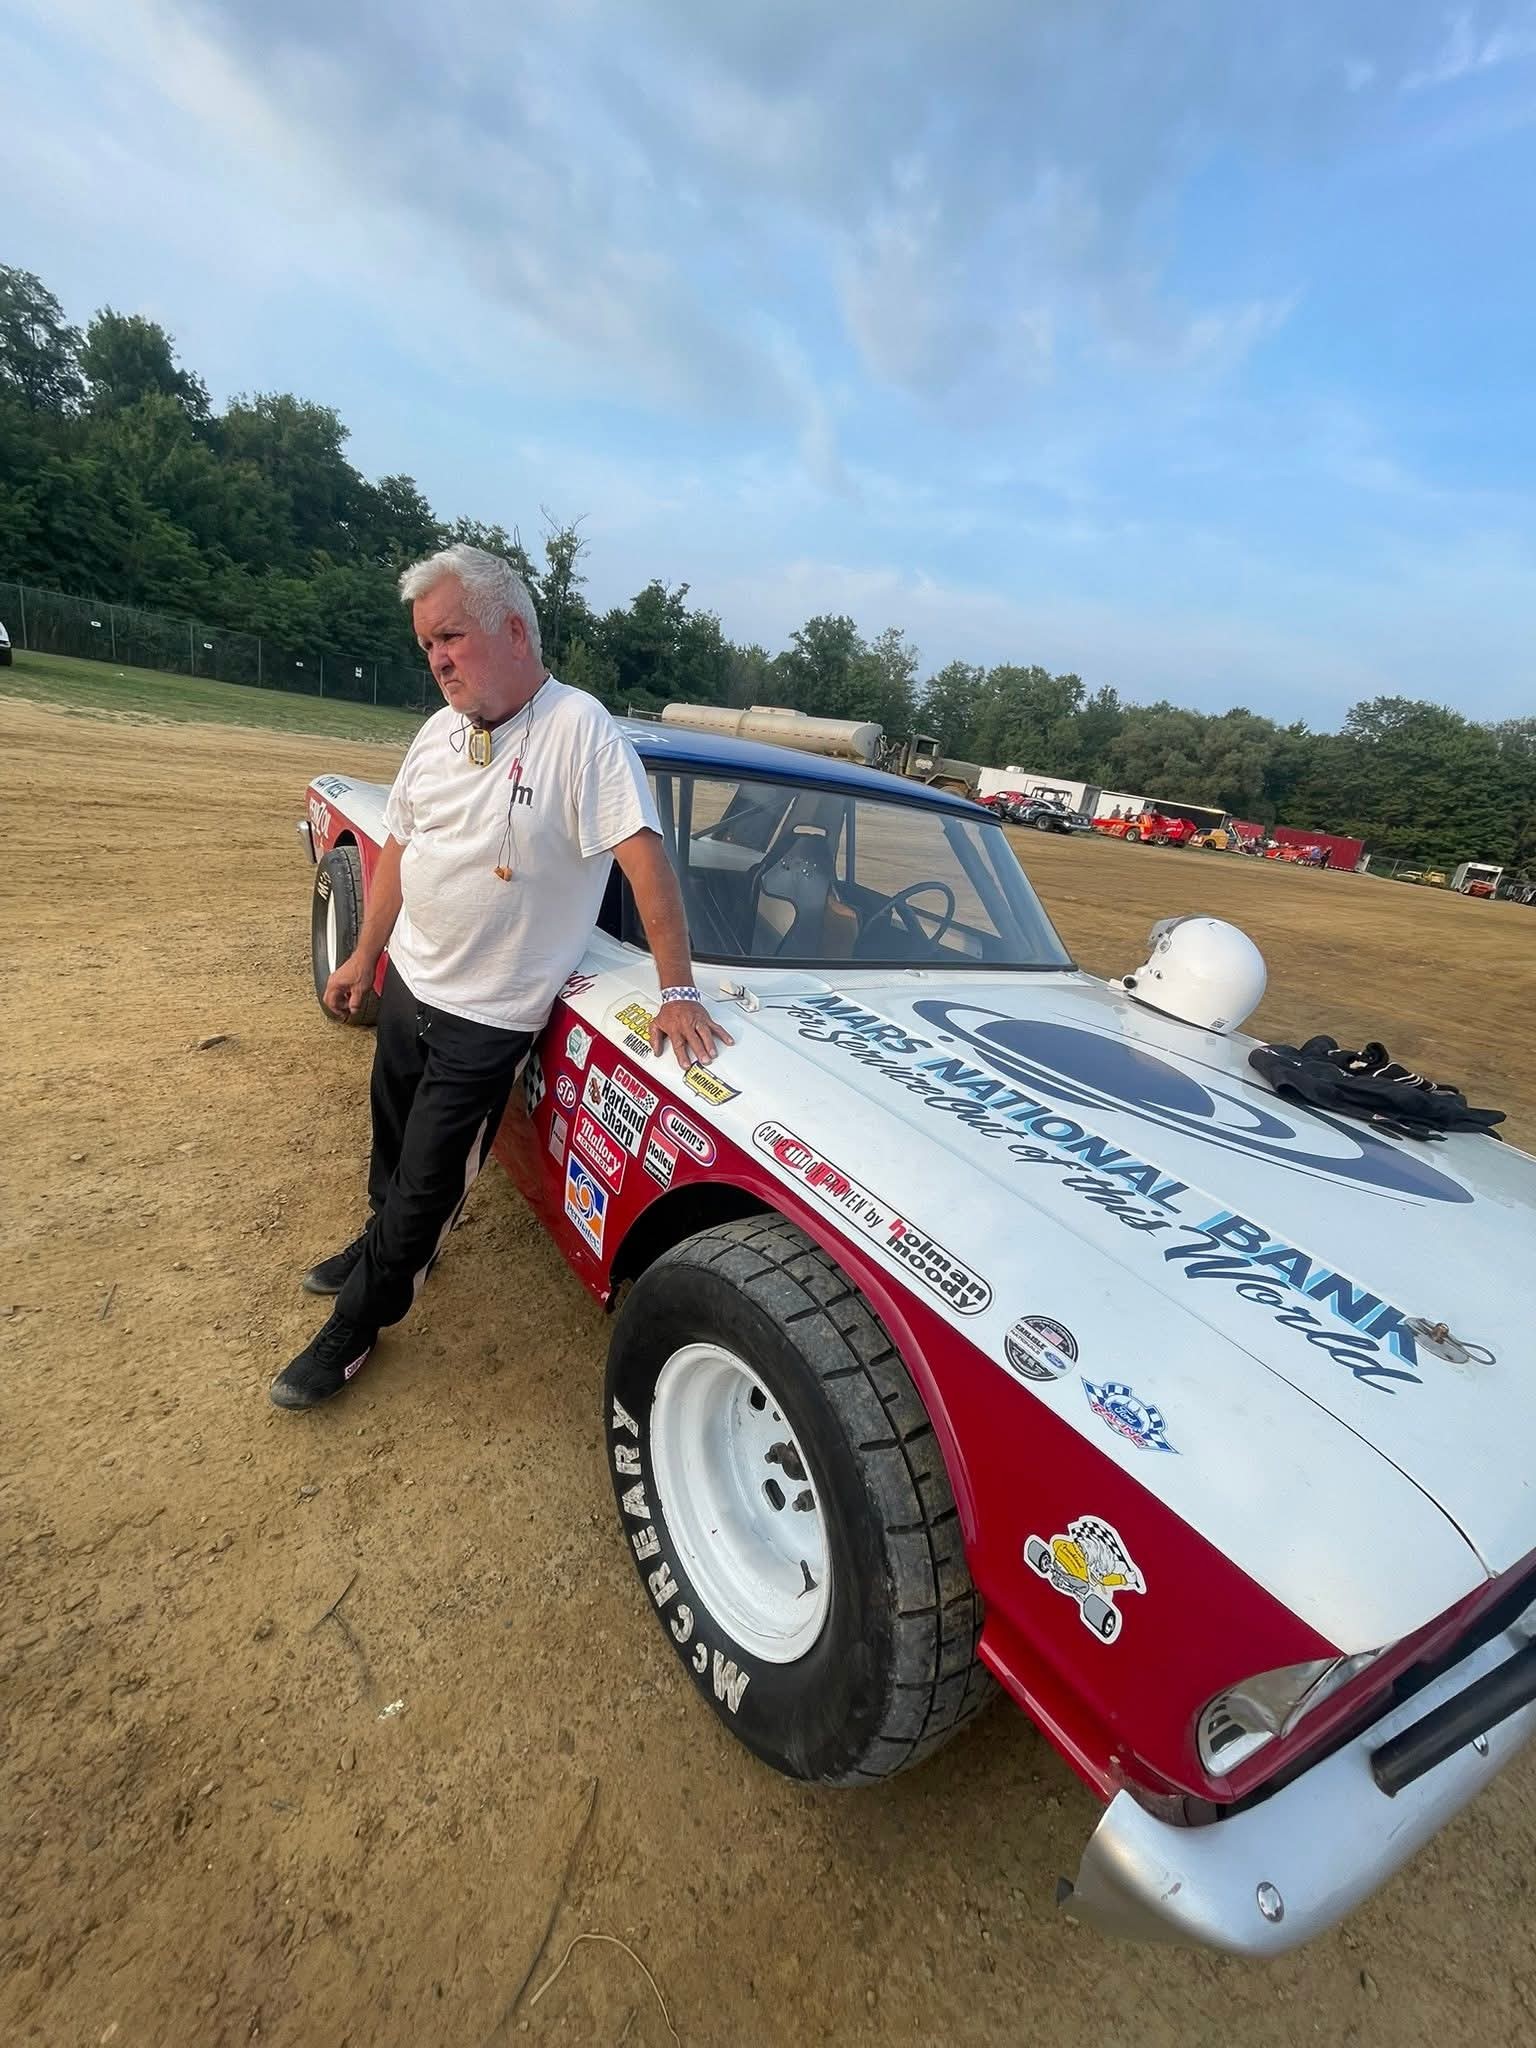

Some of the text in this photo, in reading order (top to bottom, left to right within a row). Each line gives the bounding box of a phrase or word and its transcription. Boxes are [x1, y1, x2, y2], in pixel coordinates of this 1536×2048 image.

[623, 1033, 652, 1058] HEADERS
[557, 1081, 574, 1103] STP
[615, 1067, 648, 1100] COMP
[691, 1072, 724, 1098] MONROE
[601, 1079, 647, 1134] Harland
[602, 1103, 635, 1148] Sharp
[580, 1117, 621, 1171] Mallory
[648, 1140, 674, 1176] Holley
[758, 1126, 885, 1229] COMPETITION PROVEN by
[801, 995, 1419, 1368] MARS NATIONAL BANK
[798, 1030, 945, 1095] Service
[1062, 1175, 1172, 1237] this
[1164, 1225, 1424, 1395] World
[885, 1233, 978, 1310] moody
[888, 1218, 988, 1302] holman
[1015, 1324, 1047, 1350] CARLISLE
[1092, 1402, 1148, 1448] RACING
[1114, 1406, 1138, 1425] Ford
